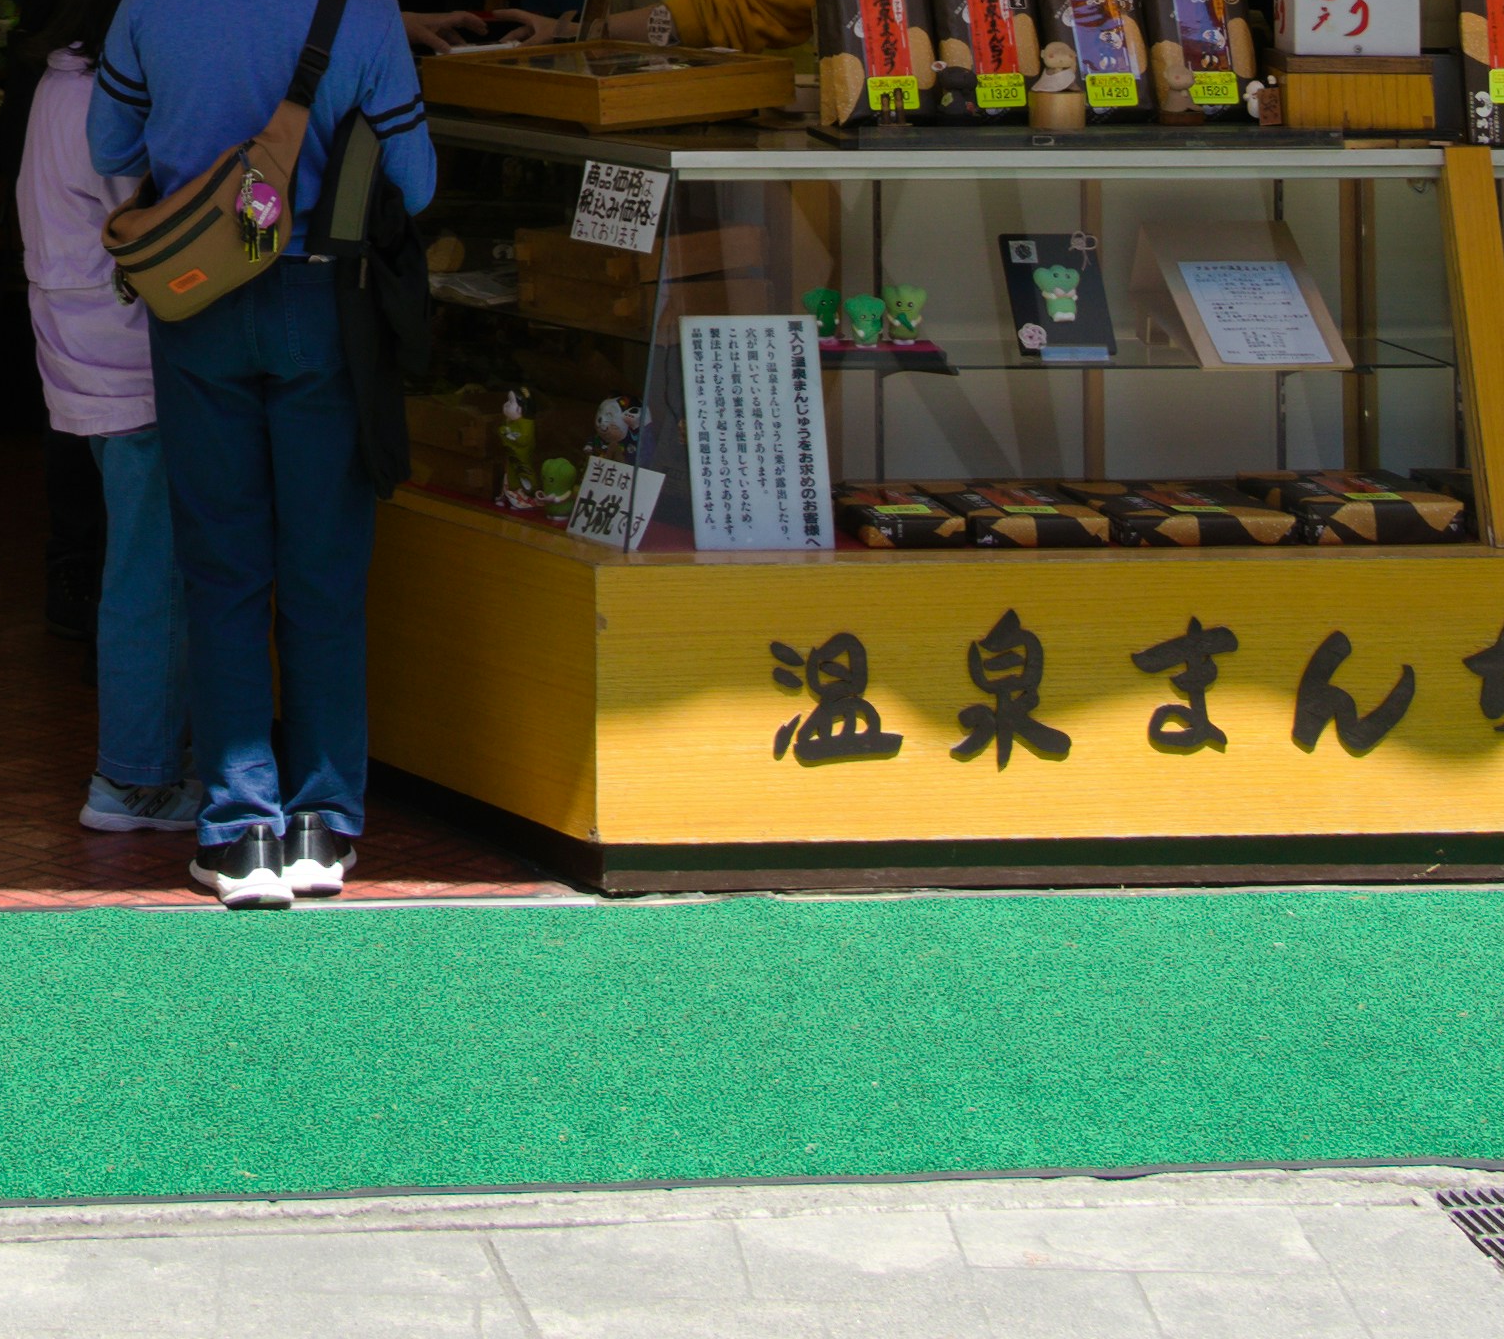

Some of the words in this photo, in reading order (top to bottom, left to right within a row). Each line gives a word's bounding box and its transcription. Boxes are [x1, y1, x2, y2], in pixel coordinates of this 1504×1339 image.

[588, 459, 631, 491] 当店は
[570, 492, 641, 539] 内税です
